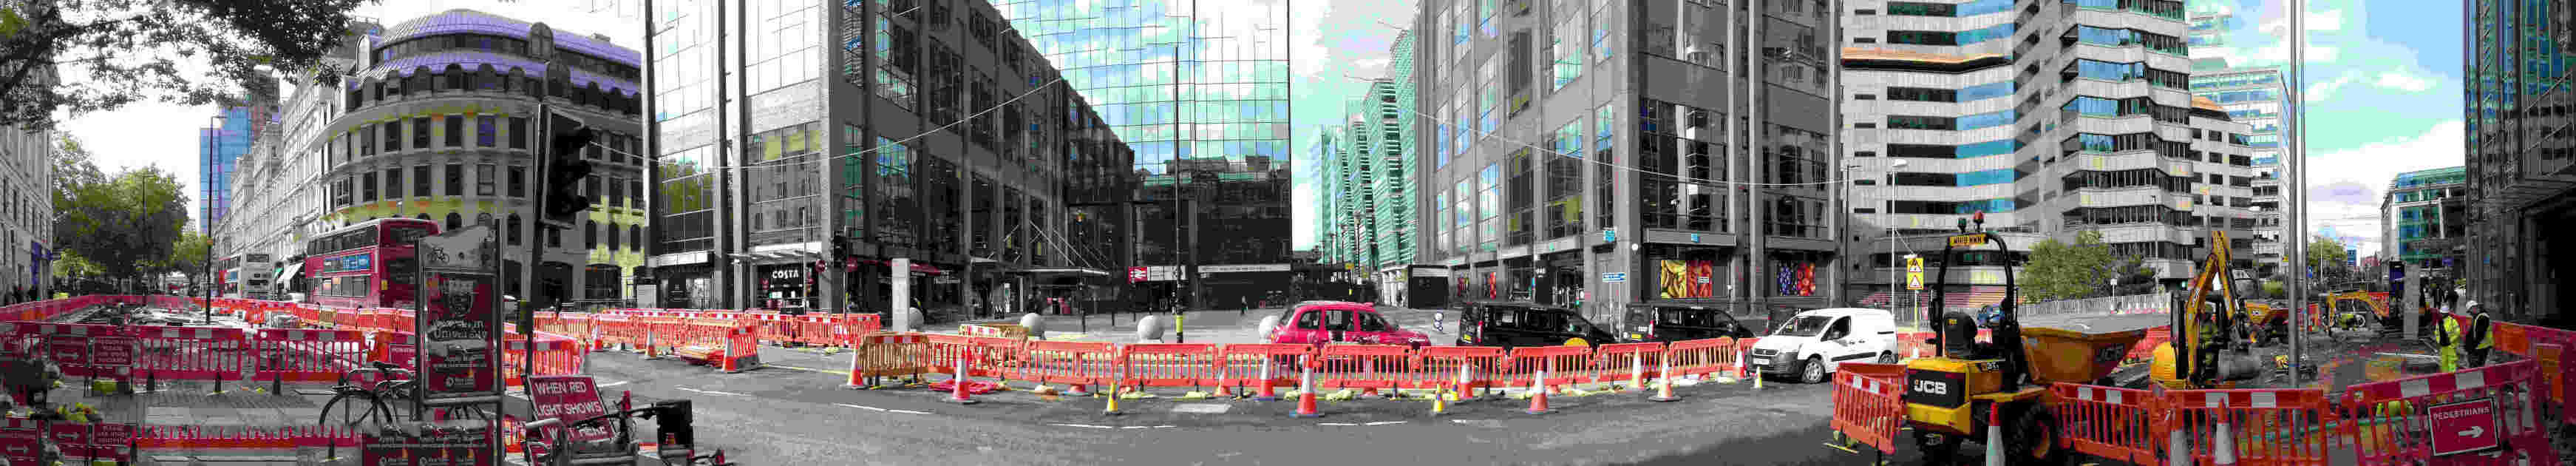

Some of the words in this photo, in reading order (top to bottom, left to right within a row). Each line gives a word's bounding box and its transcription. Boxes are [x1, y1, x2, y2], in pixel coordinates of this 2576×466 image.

[772, 269, 798, 279] COSTA
[534, 382, 568, 395] WHEN
[568, 381, 587, 393] RED
[1914, 379, 1947, 395] JCB
[563, 402, 602, 414] SHOWS
[2433, 406, 2490, 421] PEDESTRIANS
